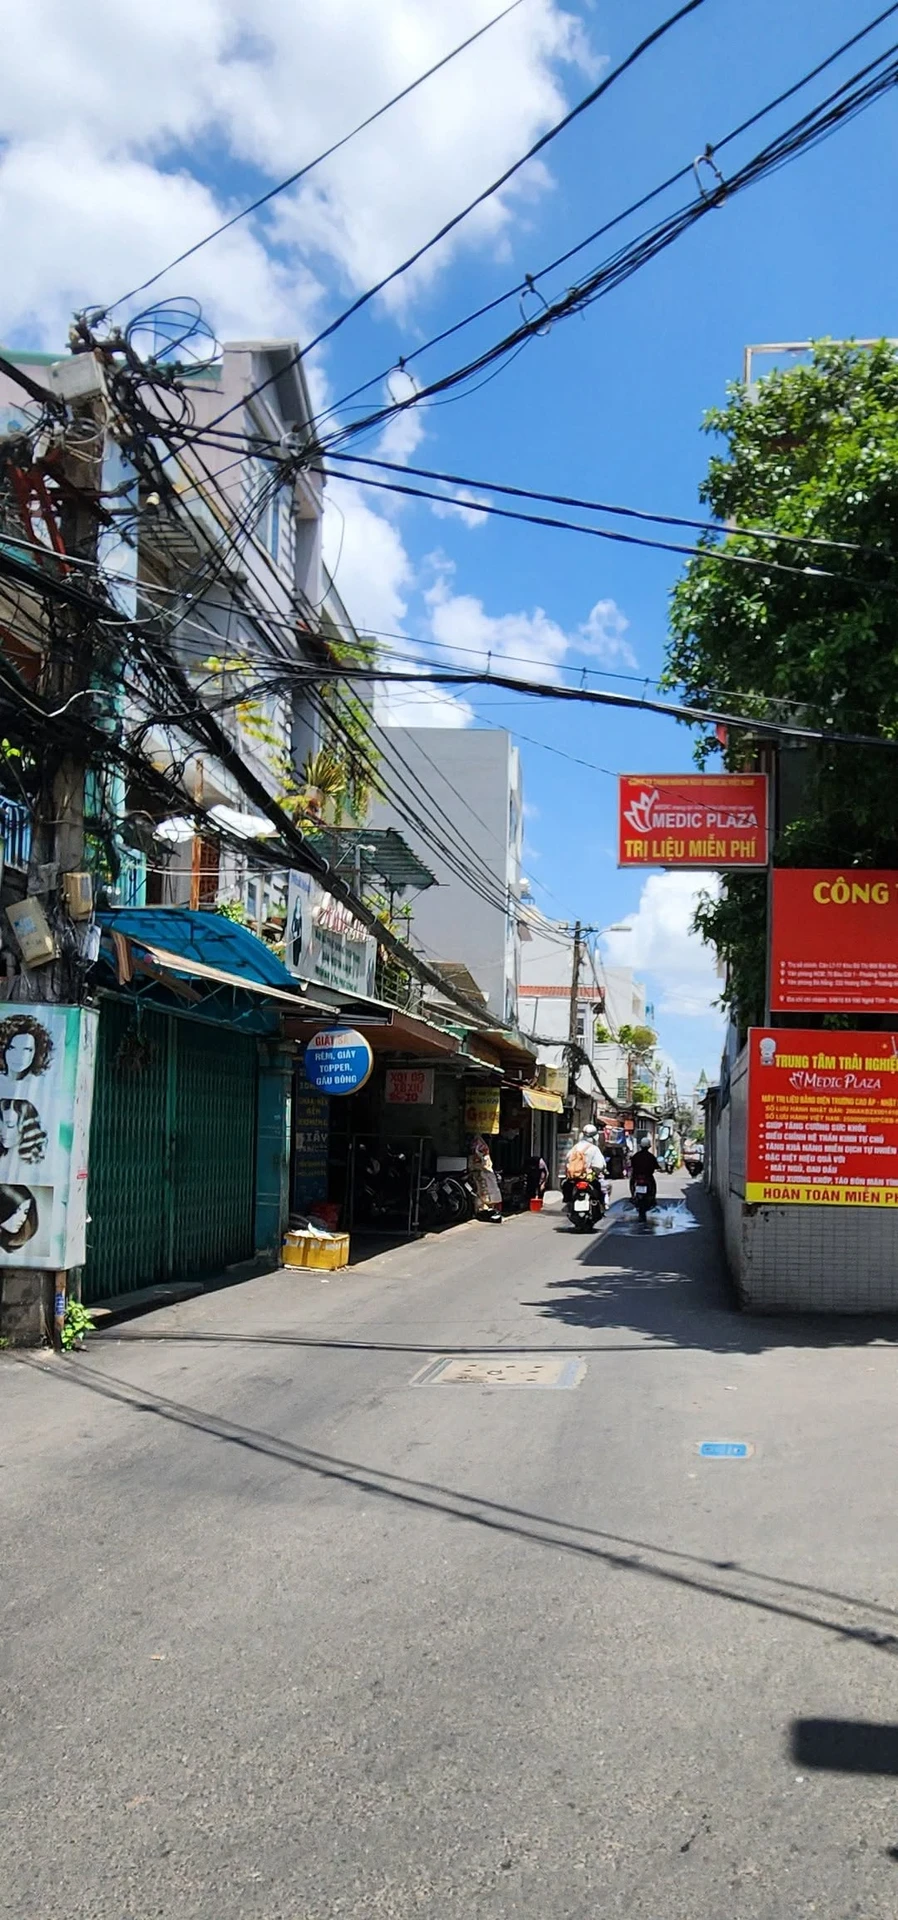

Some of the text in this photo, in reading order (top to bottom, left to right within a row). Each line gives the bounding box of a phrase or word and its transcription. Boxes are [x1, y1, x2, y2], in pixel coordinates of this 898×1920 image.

[652, 813, 758, 828] MEDIC PLAZA
[624, 834, 756, 861] TRỊ LIỆU MIỄN PHÍ
[813, 876, 889, 904] CÔNG
[775, 1054, 808, 1069] TRUNG
[812, 1052, 836, 1070] TÂM
[838, 1053, 862, 1071] TRẢI
[804, 1073, 881, 1090] MEDIC PLAZA
[763, 1185, 800, 1200] HOÀN
[805, 1186, 840, 1202] TOÀN
[845, 1186, 880, 1203] MIỄN
